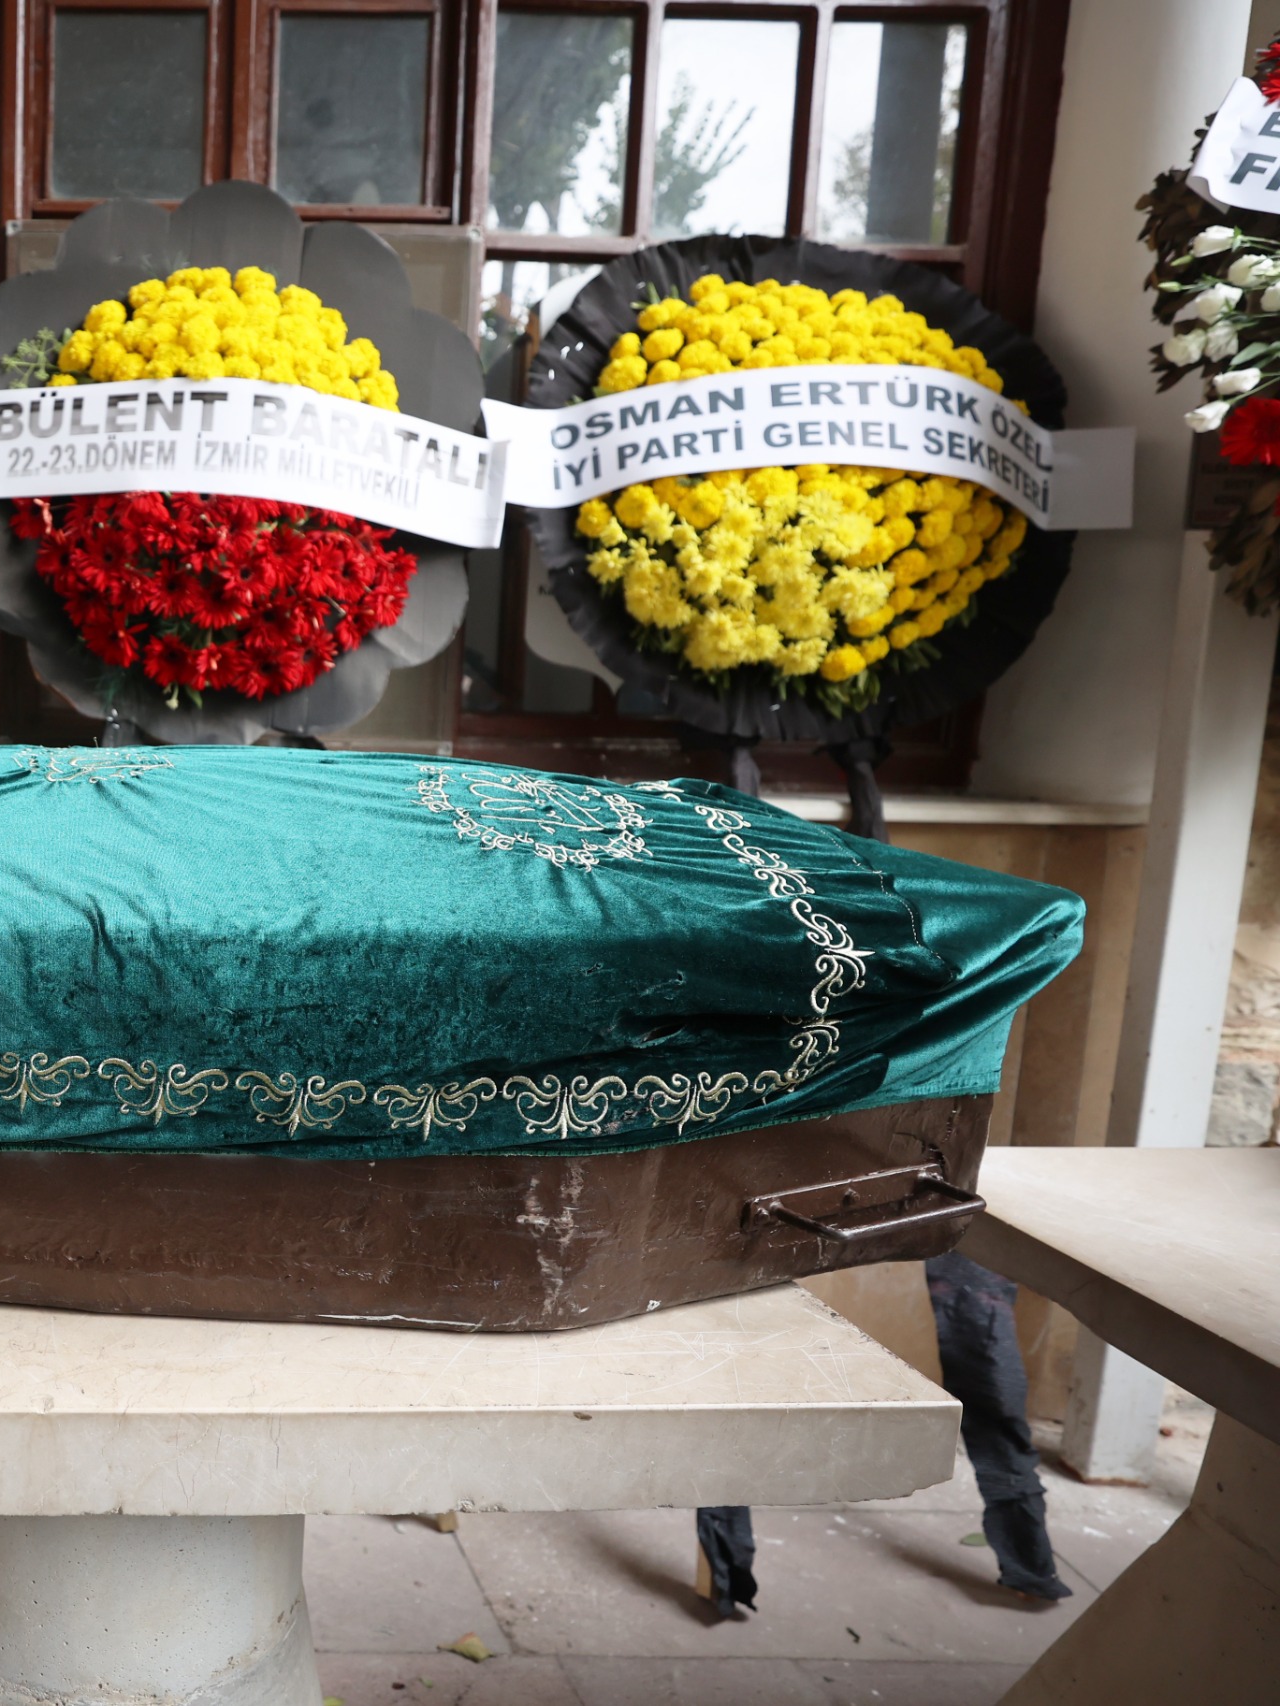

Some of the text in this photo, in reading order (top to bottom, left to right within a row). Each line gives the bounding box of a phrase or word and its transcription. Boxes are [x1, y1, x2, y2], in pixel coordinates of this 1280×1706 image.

[194, 432, 269, 475] İZMİR
[278, 443, 420, 511] MİLLETVEKİLİ
[250, 394, 489, 490] BARATALI
[550, 375, 1054, 473] OSMAN ERTÜRK ÖZEL
[552, 419, 1050, 514] İYİ PARTİ GENEL SEKRETERİ
